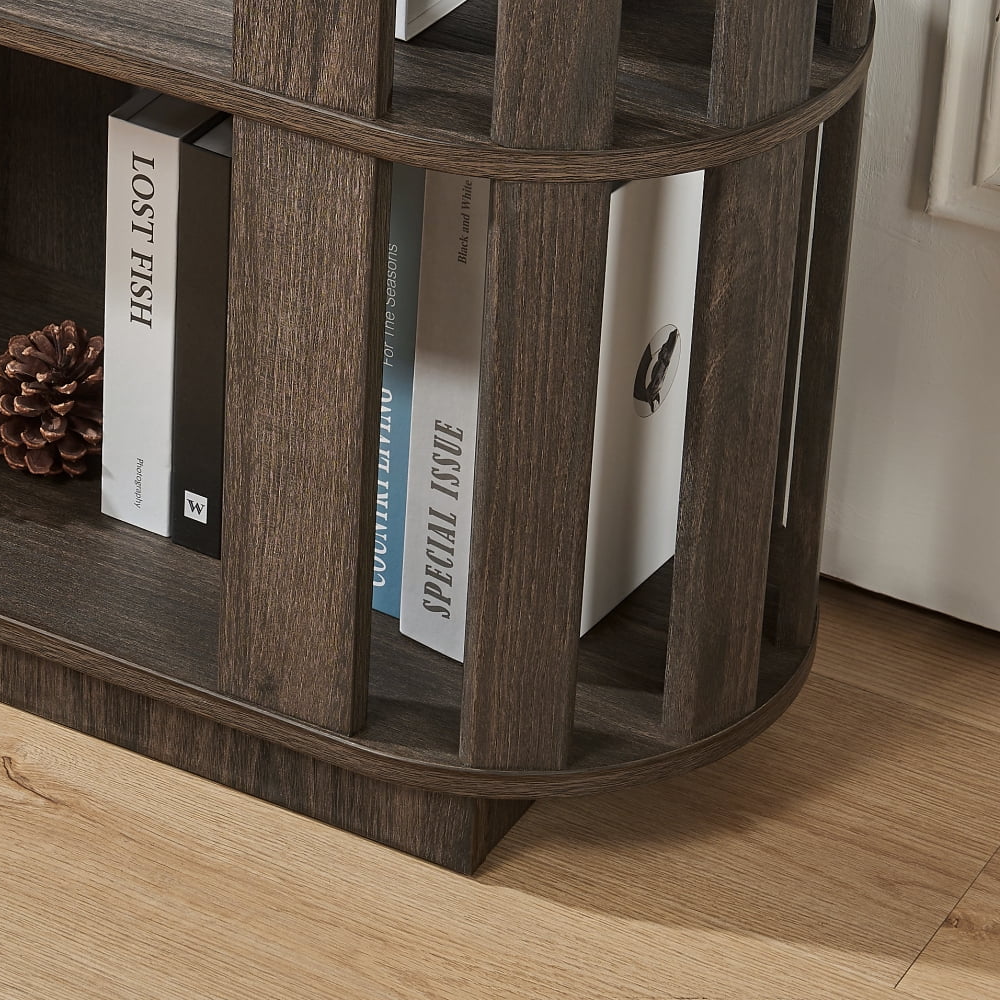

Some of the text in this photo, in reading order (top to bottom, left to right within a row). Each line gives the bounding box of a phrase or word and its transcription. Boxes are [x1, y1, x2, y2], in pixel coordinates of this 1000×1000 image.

[129, 150, 155, 329] LOST FISH
[457, 179, 473, 265] Black and White
[385, 243, 398, 308] Seasons
[133, 457, 144, 509] Photography
[186, 498, 205, 515] W
[421, 418, 465, 620] SPECIAL ISSUE
